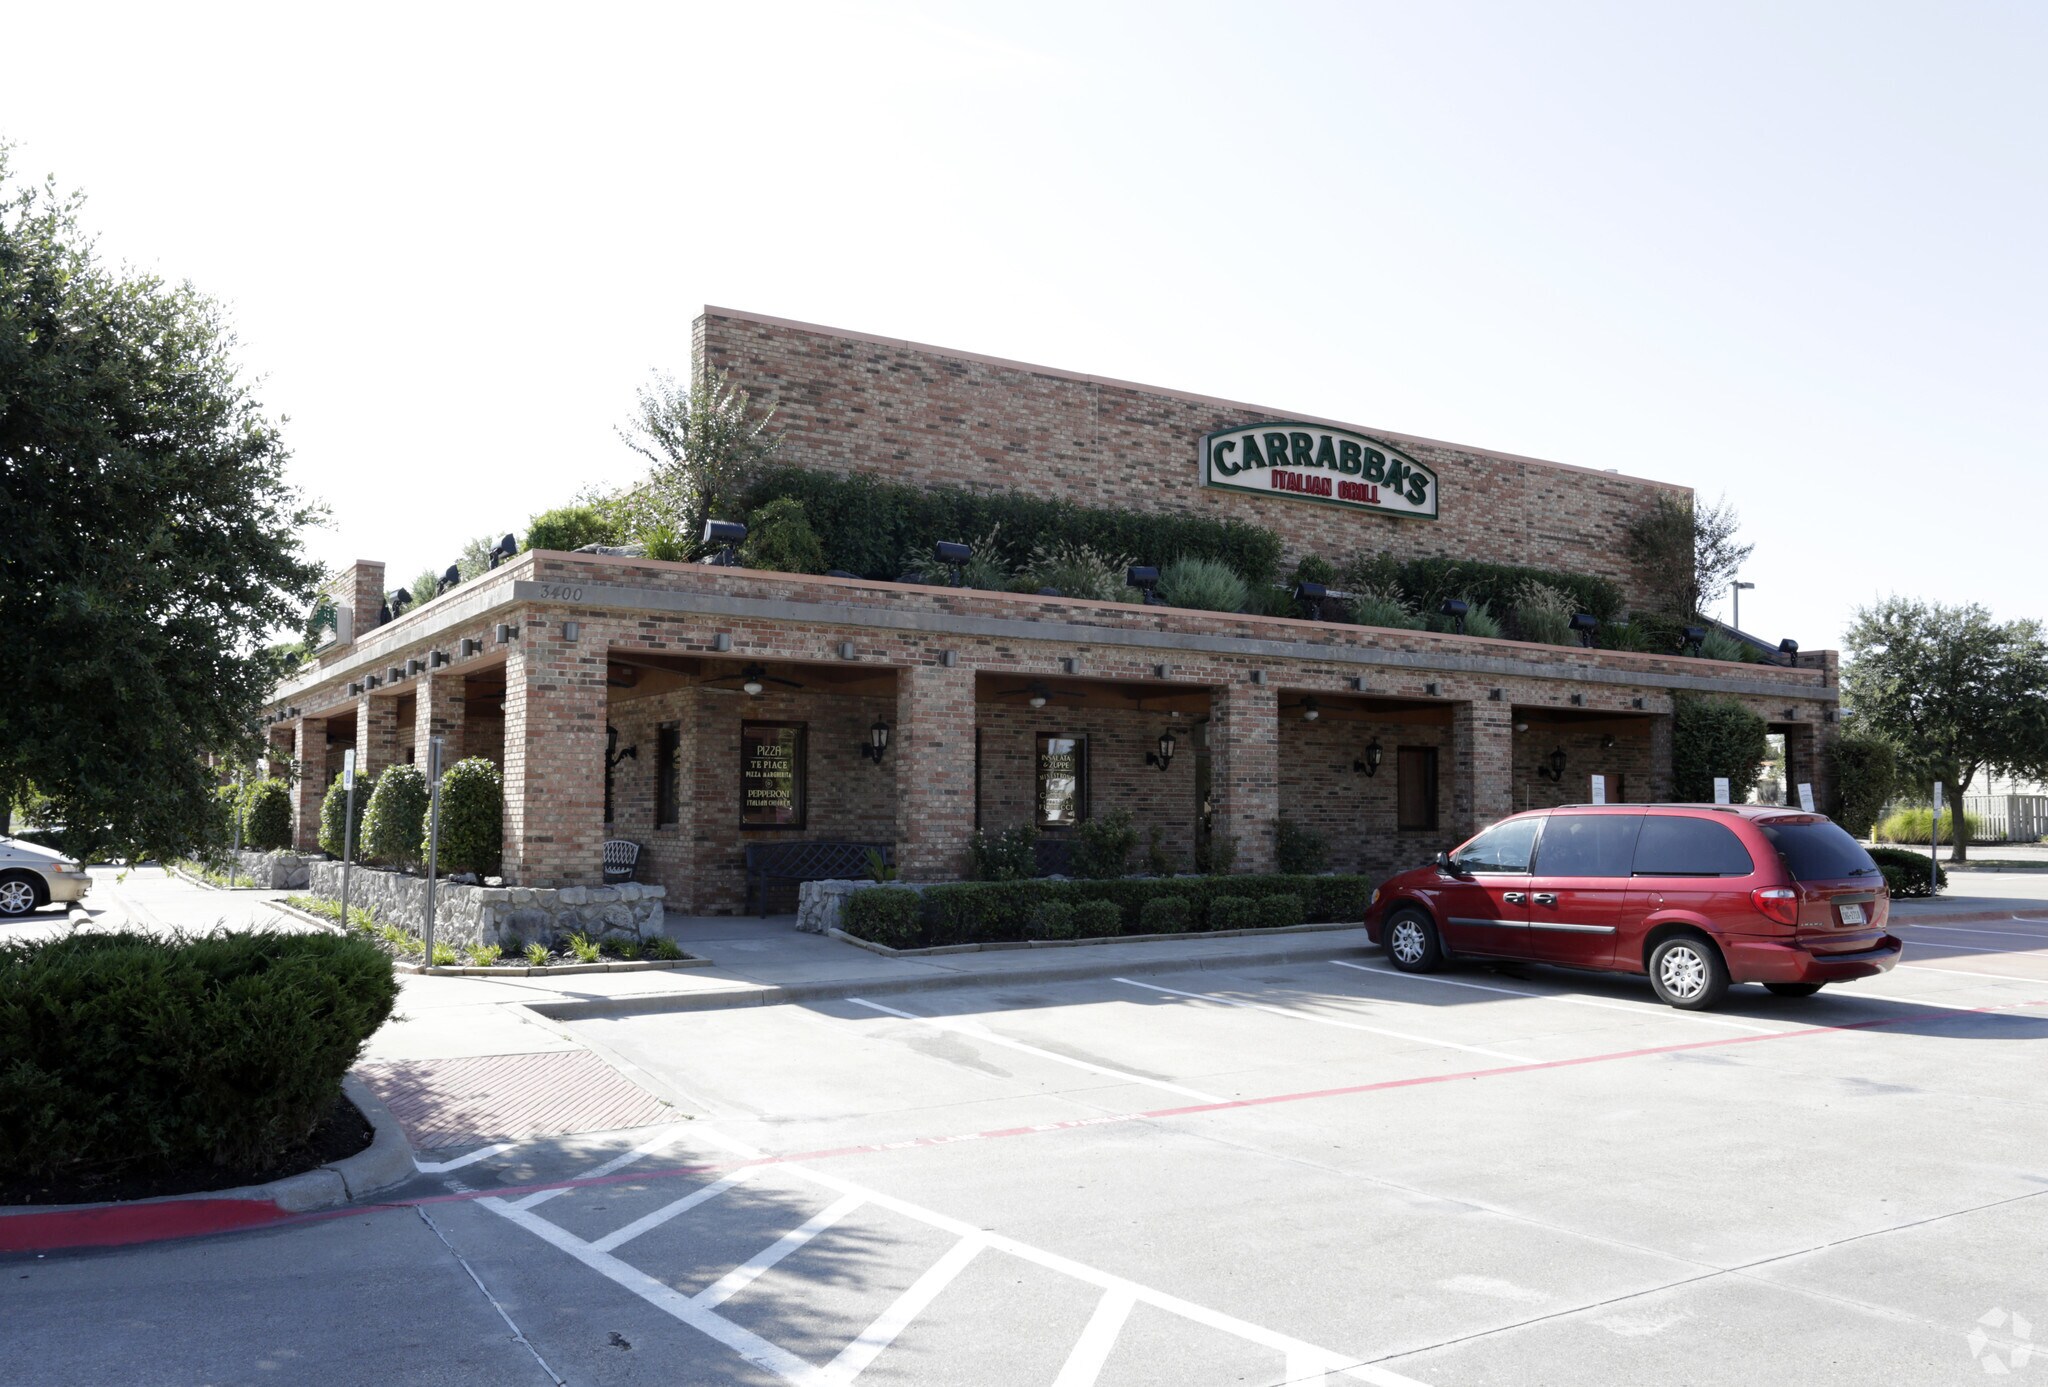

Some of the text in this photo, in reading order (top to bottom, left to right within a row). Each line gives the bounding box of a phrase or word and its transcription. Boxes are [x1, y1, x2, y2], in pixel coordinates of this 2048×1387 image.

[1213, 432, 1430, 506] CARRABBA'S
[1271, 469, 1381, 504] ITALIAN GRILL
[540, 584, 582, 601] 3400
[757, 745, 781, 756] PIZZA
[751, 760, 788, 769] TE PIACE
[748, 790, 790, 798] PEPPERONI
